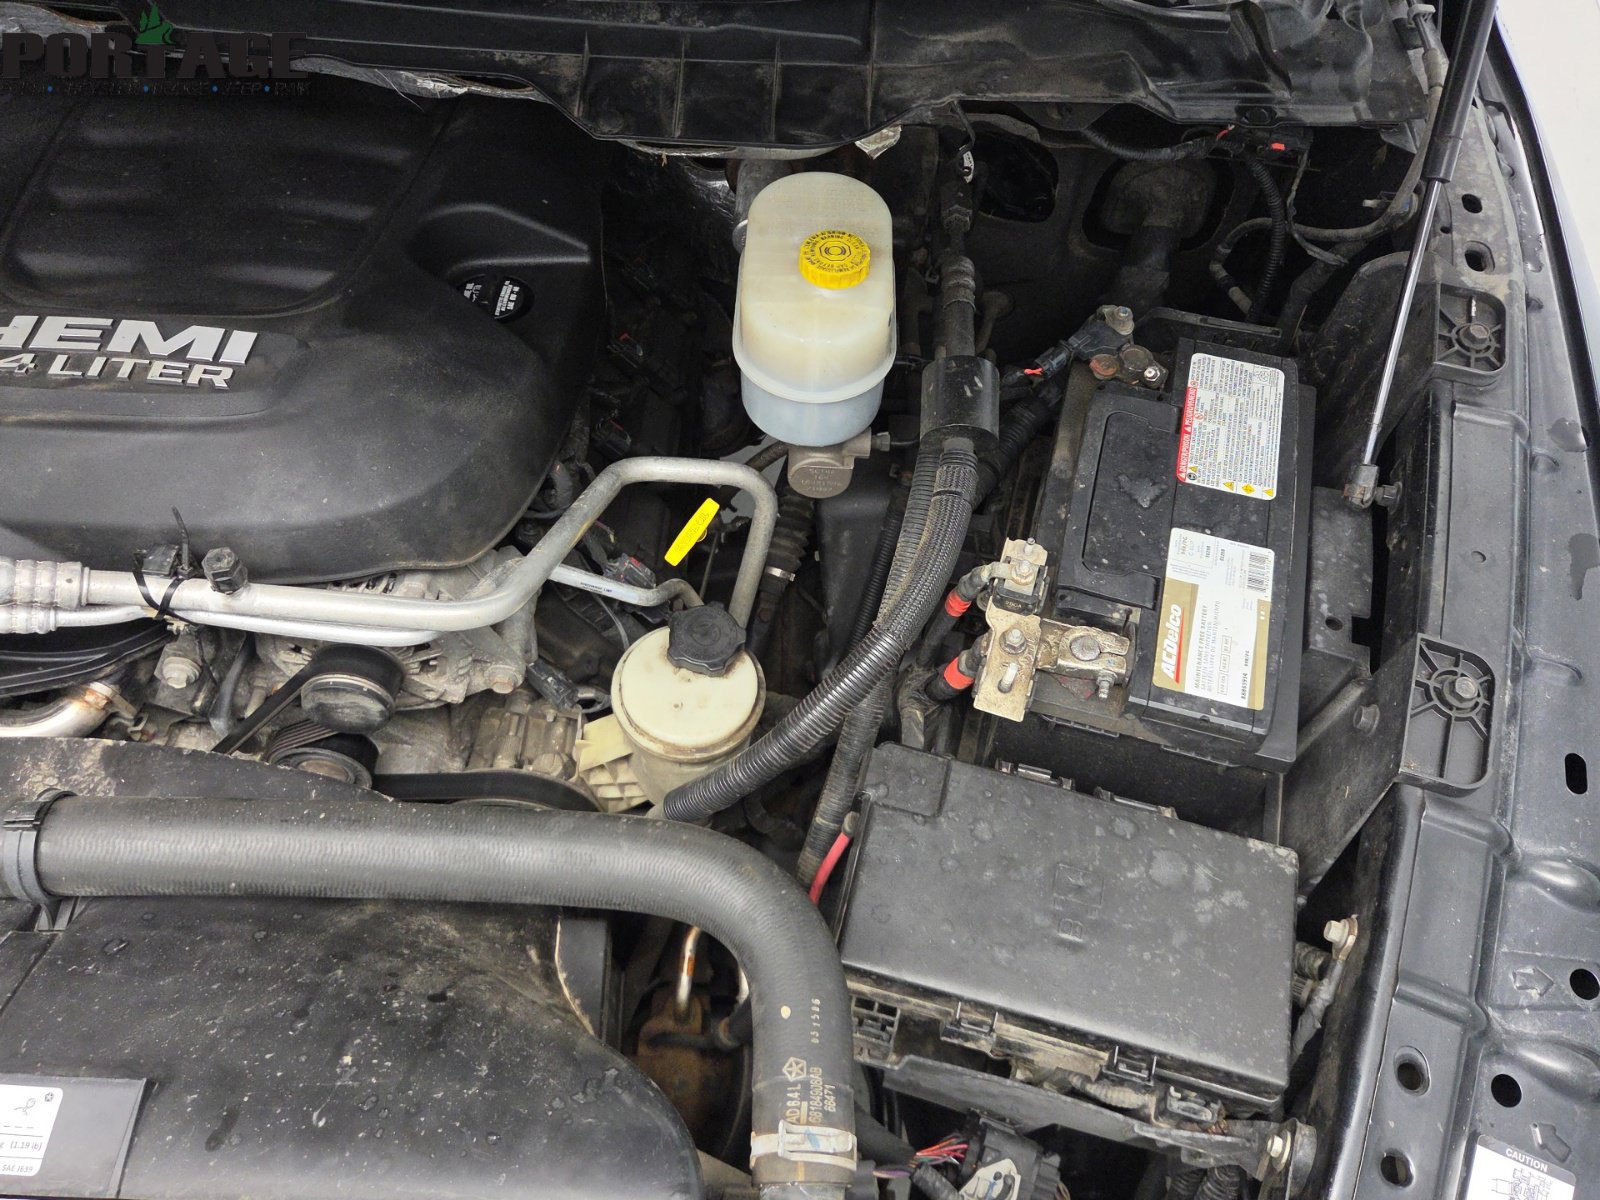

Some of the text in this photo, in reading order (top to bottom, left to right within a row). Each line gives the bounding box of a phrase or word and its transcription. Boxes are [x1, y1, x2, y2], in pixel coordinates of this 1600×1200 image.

[47, 354, 235, 391] LITER
[1162, 604, 1182, 679] ACDelco
[2, 1164, 15, 1172] SAE
[1505, 1148, 1548, 1173] CAUTION
